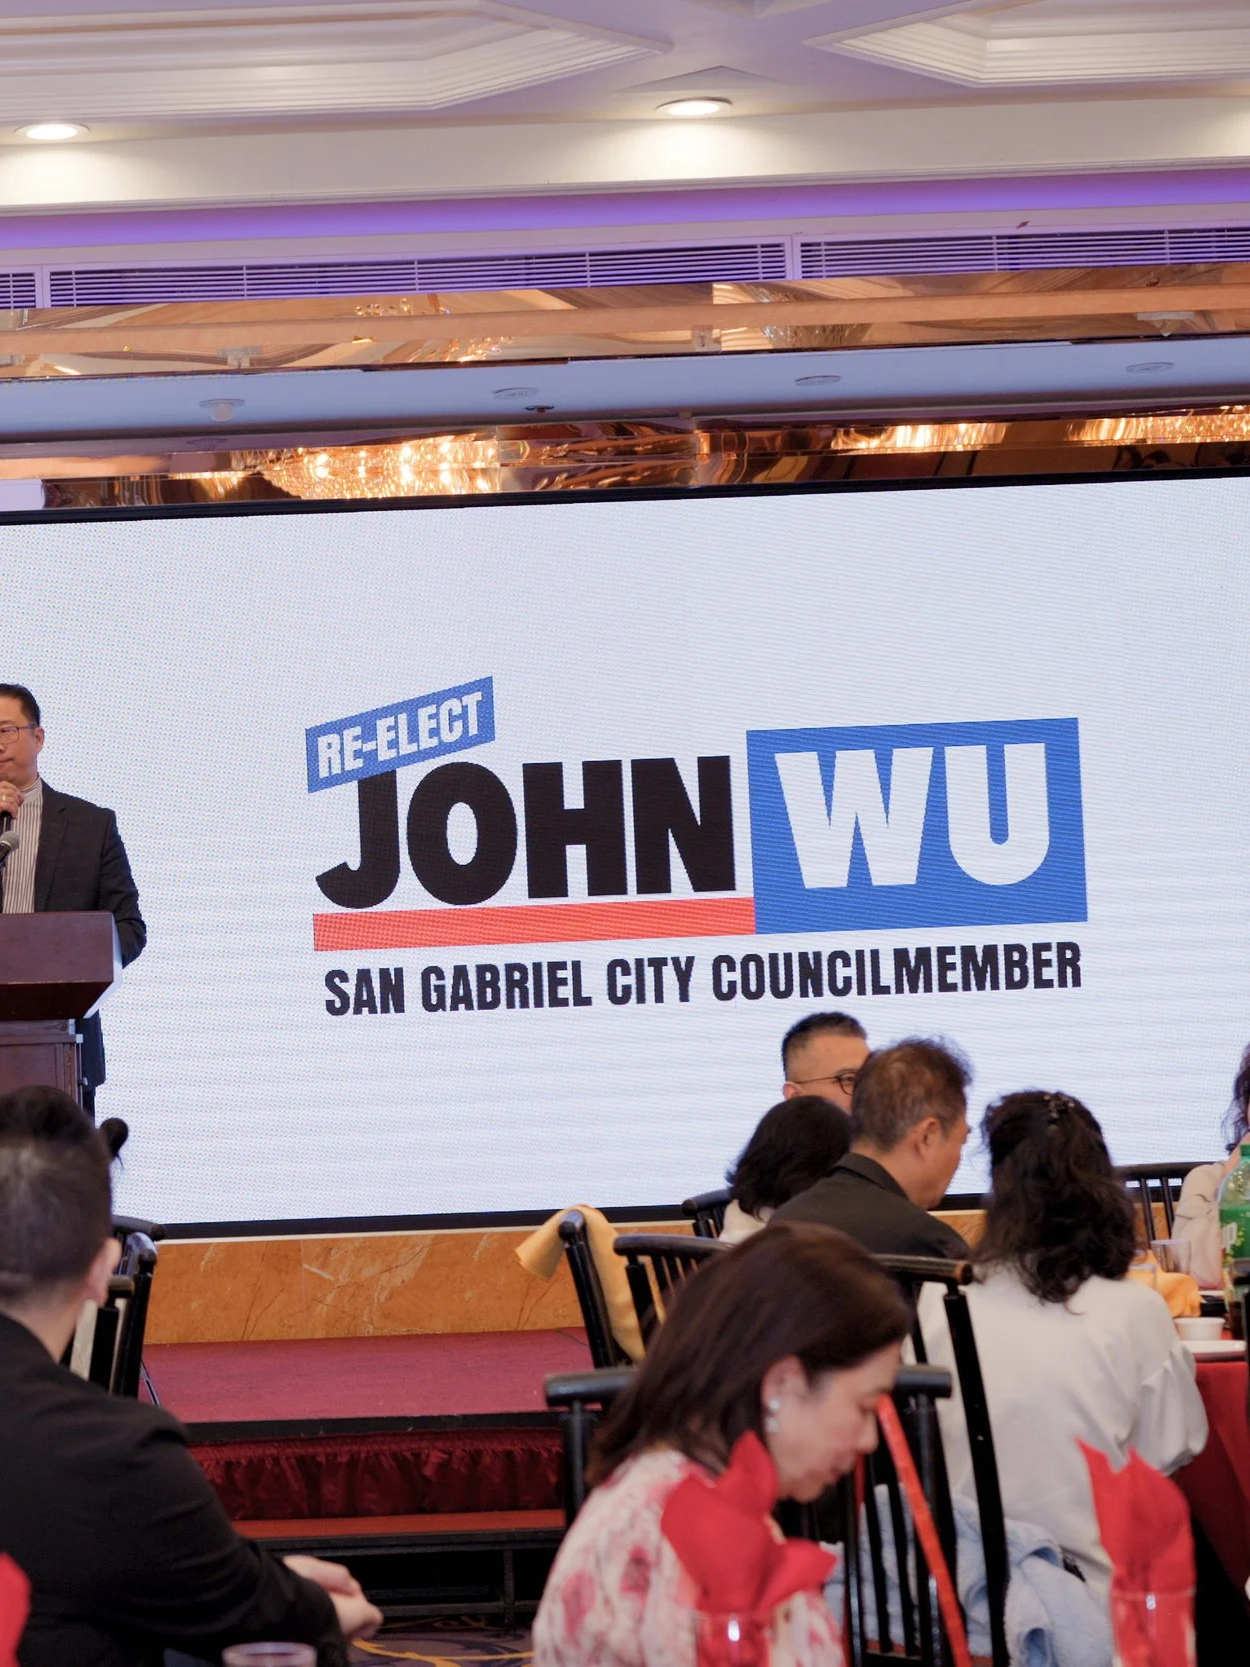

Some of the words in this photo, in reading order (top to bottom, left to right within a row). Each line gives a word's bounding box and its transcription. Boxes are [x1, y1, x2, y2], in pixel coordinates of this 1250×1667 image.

[317, 691, 483, 778] RE-ELECT
[315, 756, 736, 909] JOHN
[774, 742, 1050, 889] WU
[325, 967, 405, 1016] SAN
[421, 960, 592, 1012] GABRIEL
[607, 956, 695, 1005] CITY
[712, 942, 1082, 1001] COUNCILMEMBER
